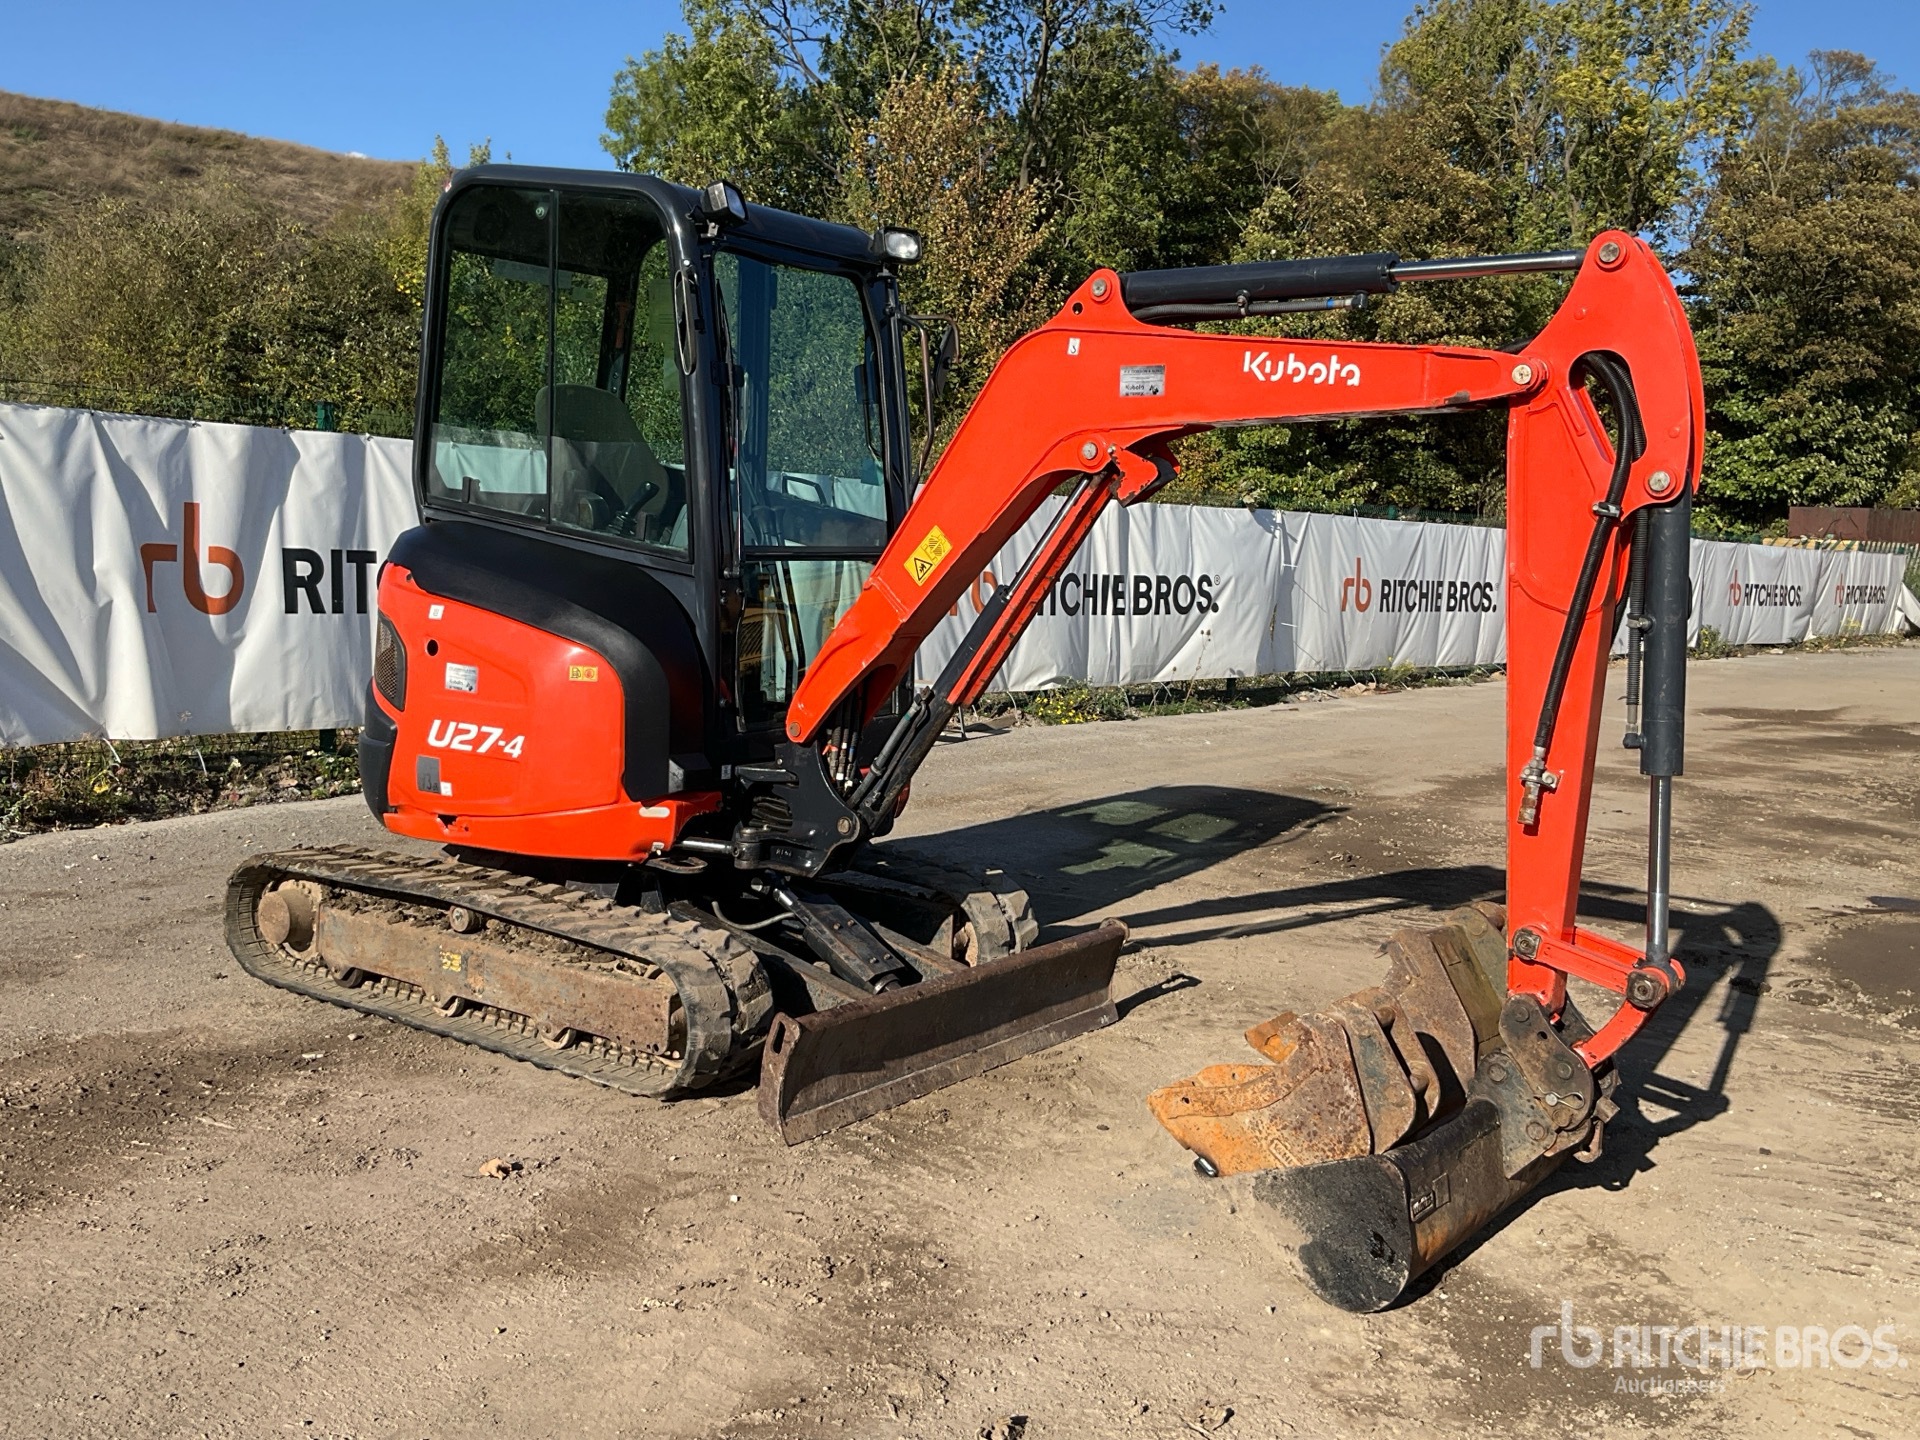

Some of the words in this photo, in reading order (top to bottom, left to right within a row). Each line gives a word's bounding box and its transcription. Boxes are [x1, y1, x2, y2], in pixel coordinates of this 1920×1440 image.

[1243, 350, 1361, 387] Kubota
[140, 501, 245, 615] rb
[1340, 557, 1372, 613] rb
[1379, 579, 1444, 613] RITCHIE
[1743, 583, 1778, 607] RITCHIE
[1779, 584, 1802, 607] BROS.
[427, 719, 525, 759] U27-4
